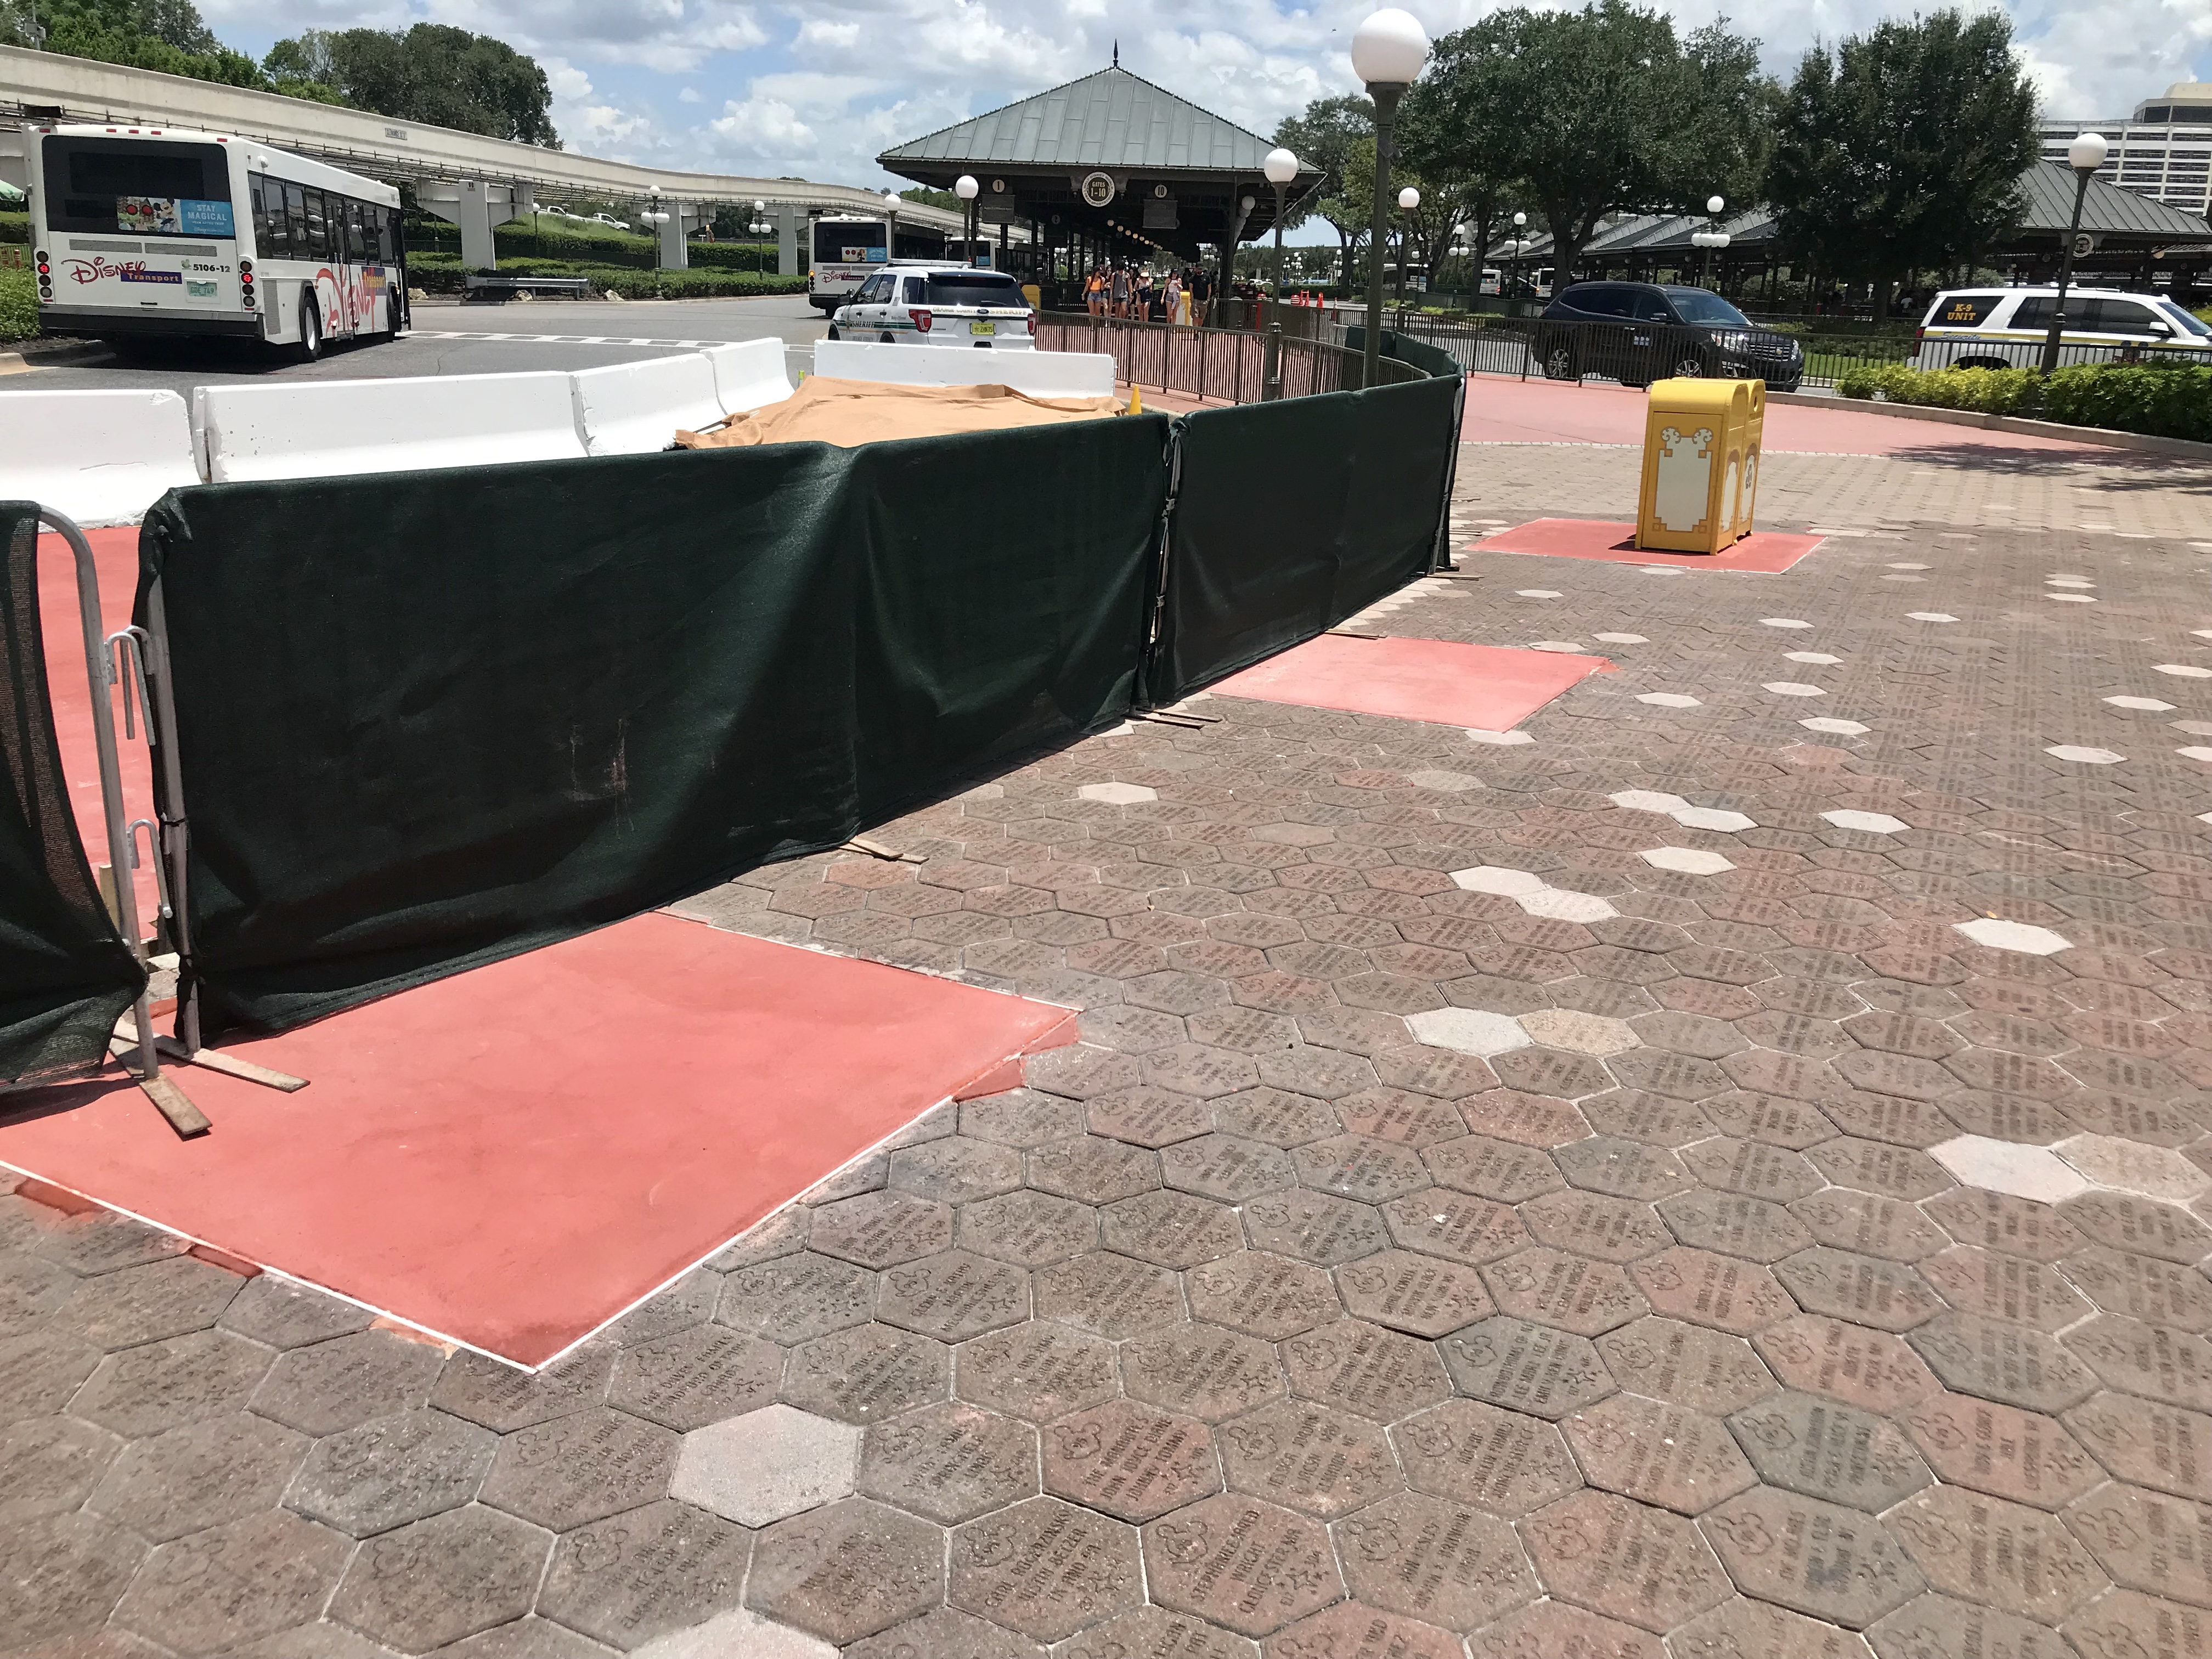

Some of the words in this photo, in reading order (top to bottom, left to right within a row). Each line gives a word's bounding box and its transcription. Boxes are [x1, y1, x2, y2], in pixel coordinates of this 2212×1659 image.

[1158, 187, 1164, 196] 10
[188, 211, 227, 221] MAGICAL
[127, 273, 179, 282] Transport
[193, 264, 230, 272] 5106-12
[1947, 312, 1977, 320] UNIT
[1954, 303, 1972, 312] K-9
[941, 1262, 978, 1287] KATHY
[940, 1280, 978, 1308] MARTIN
[1418, 1303, 1440, 1321] NEW
[693, 1333, 738, 1362] FAMILY
[697, 1363, 746, 1397] CANADA
[1153, 1428, 1190, 1464] TOMMY
[1098, 1474, 1129, 1501] JOHN
[1120, 1445, 1152, 1474] JOYCE
[1144, 1417, 1175, 1443] DIANE
[1082, 1468, 1108, 1488] THE
[1228, 1540, 1267, 1583] WRIGHT
[1238, 1546, 1293, 1615] GLOUCESTER
[1280, 1527, 1304, 1547] MA
